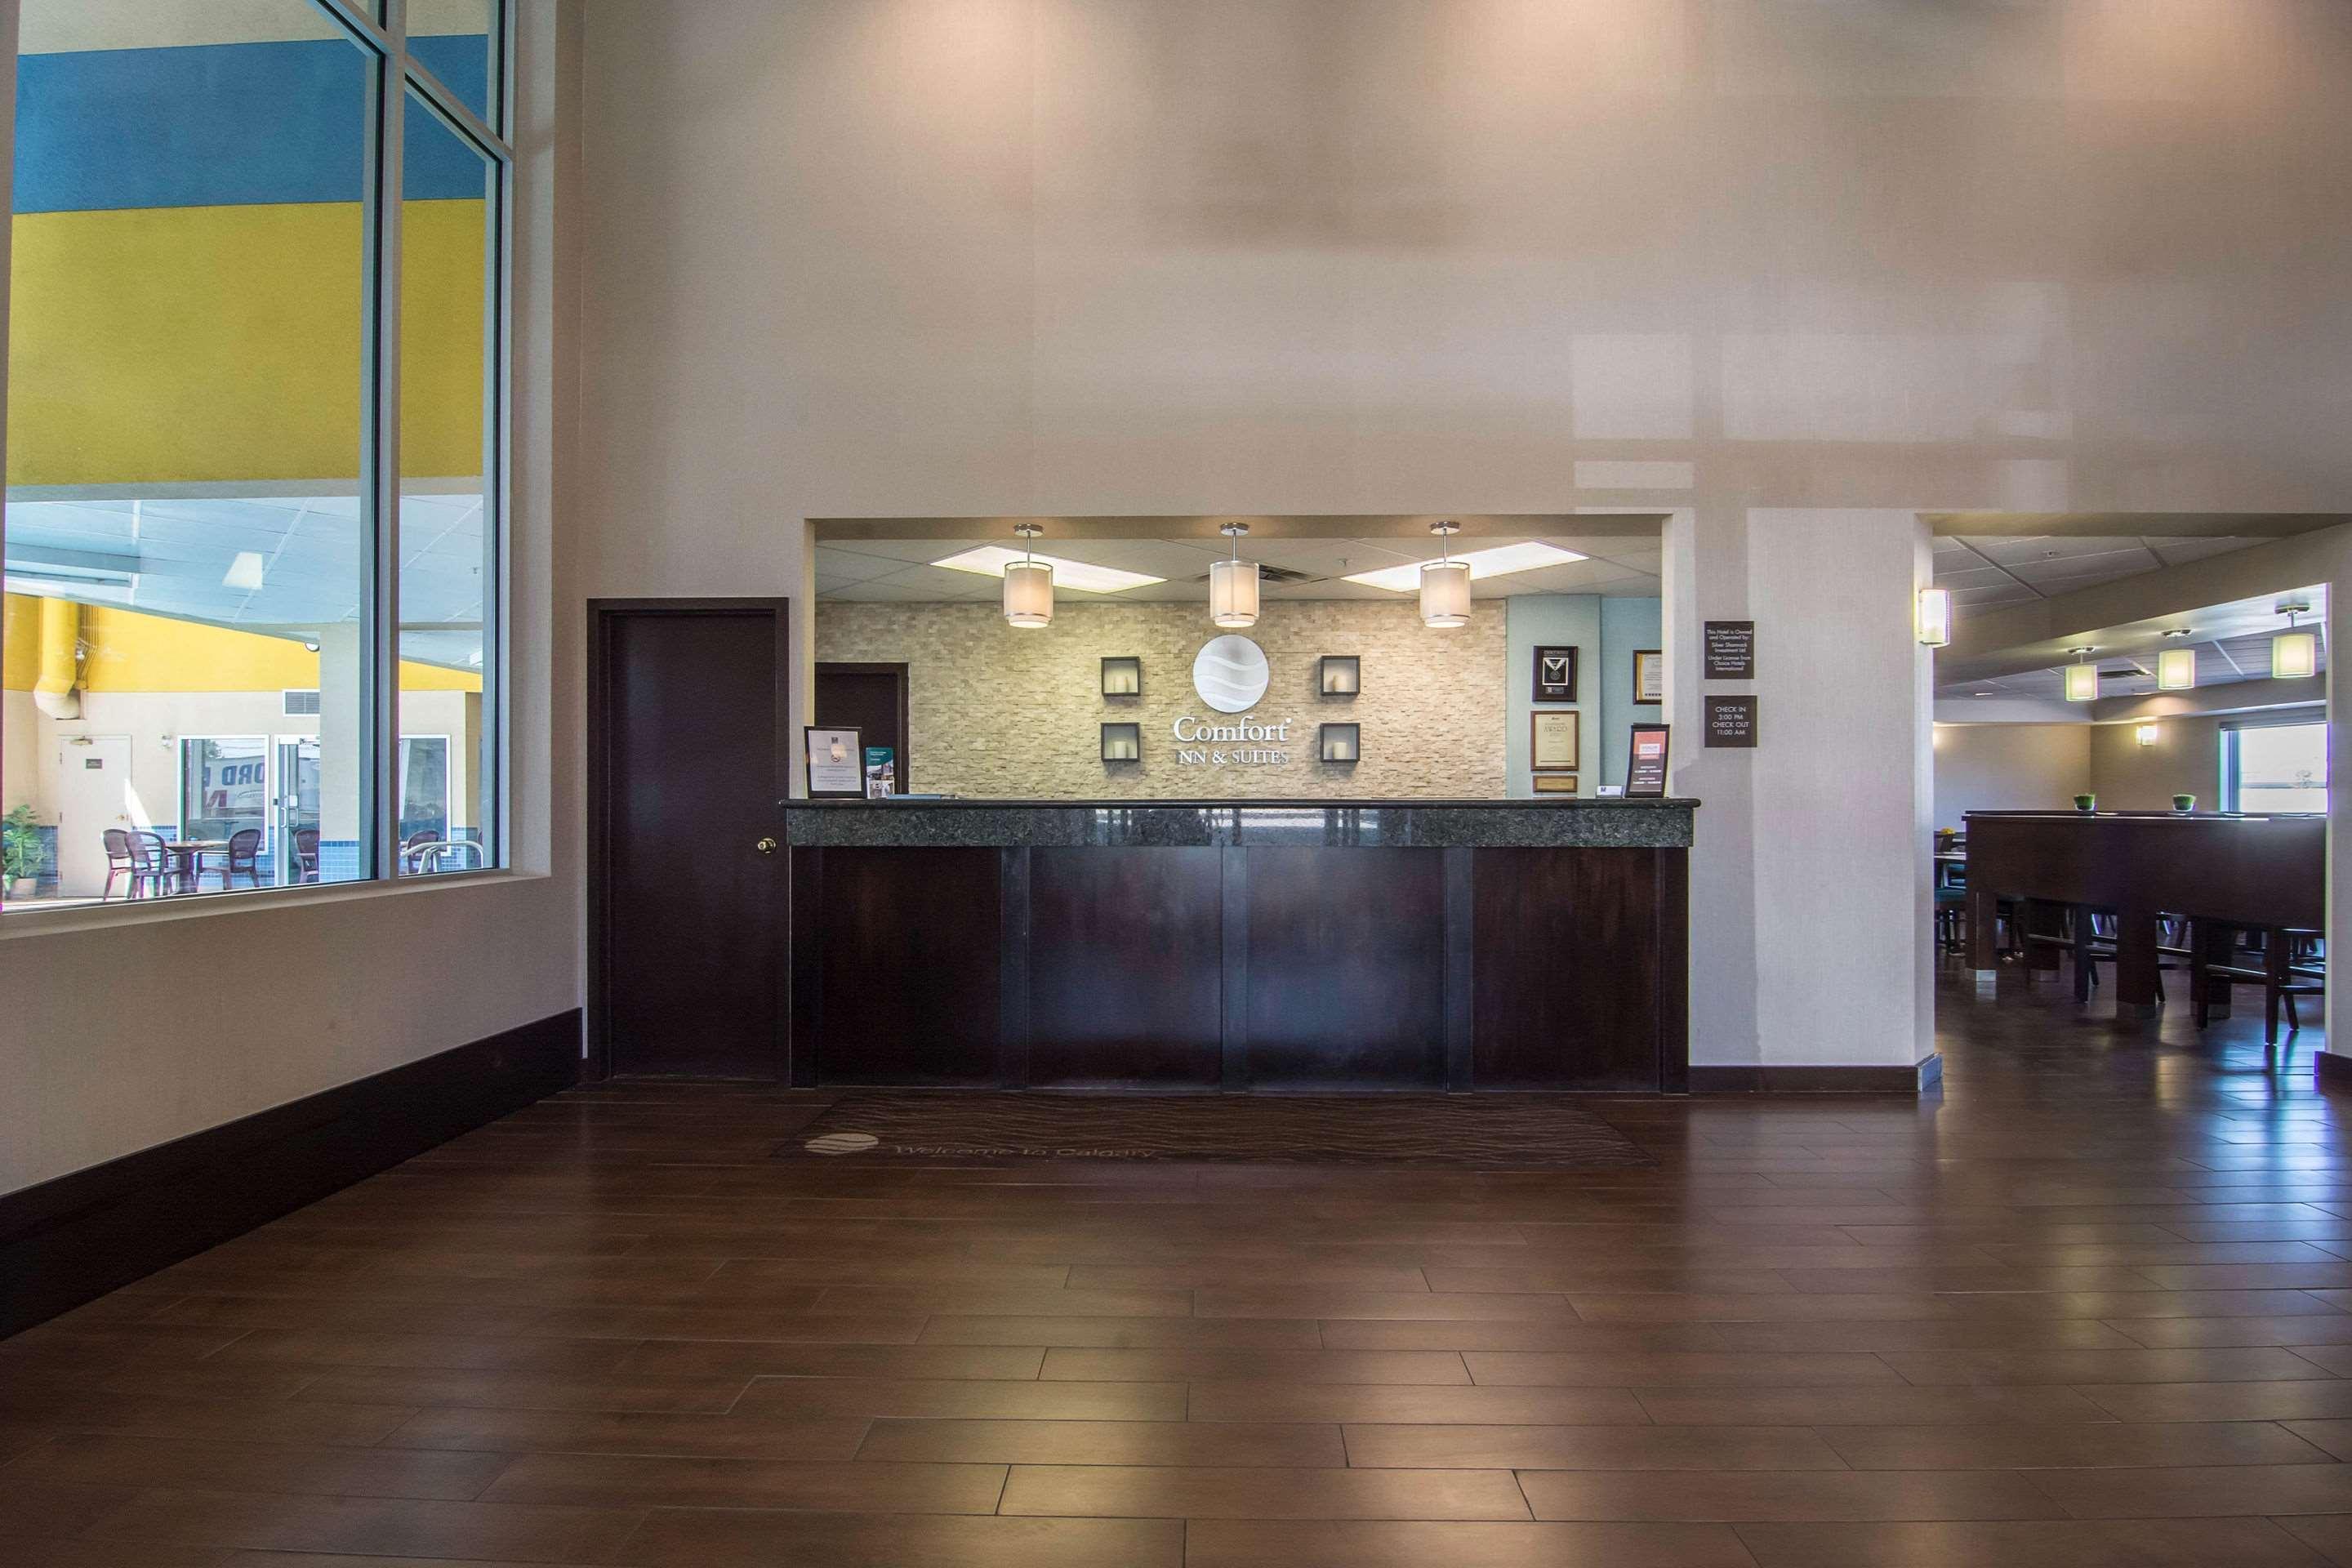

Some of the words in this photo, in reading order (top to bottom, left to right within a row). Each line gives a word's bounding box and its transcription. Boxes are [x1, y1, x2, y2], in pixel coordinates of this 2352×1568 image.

[1173, 715, 1289, 742] Comfort
[1212, 751, 1227, 764] &
[1232, 751, 1289, 764] SUITES
[895, 1146, 1014, 1156] Welcome
